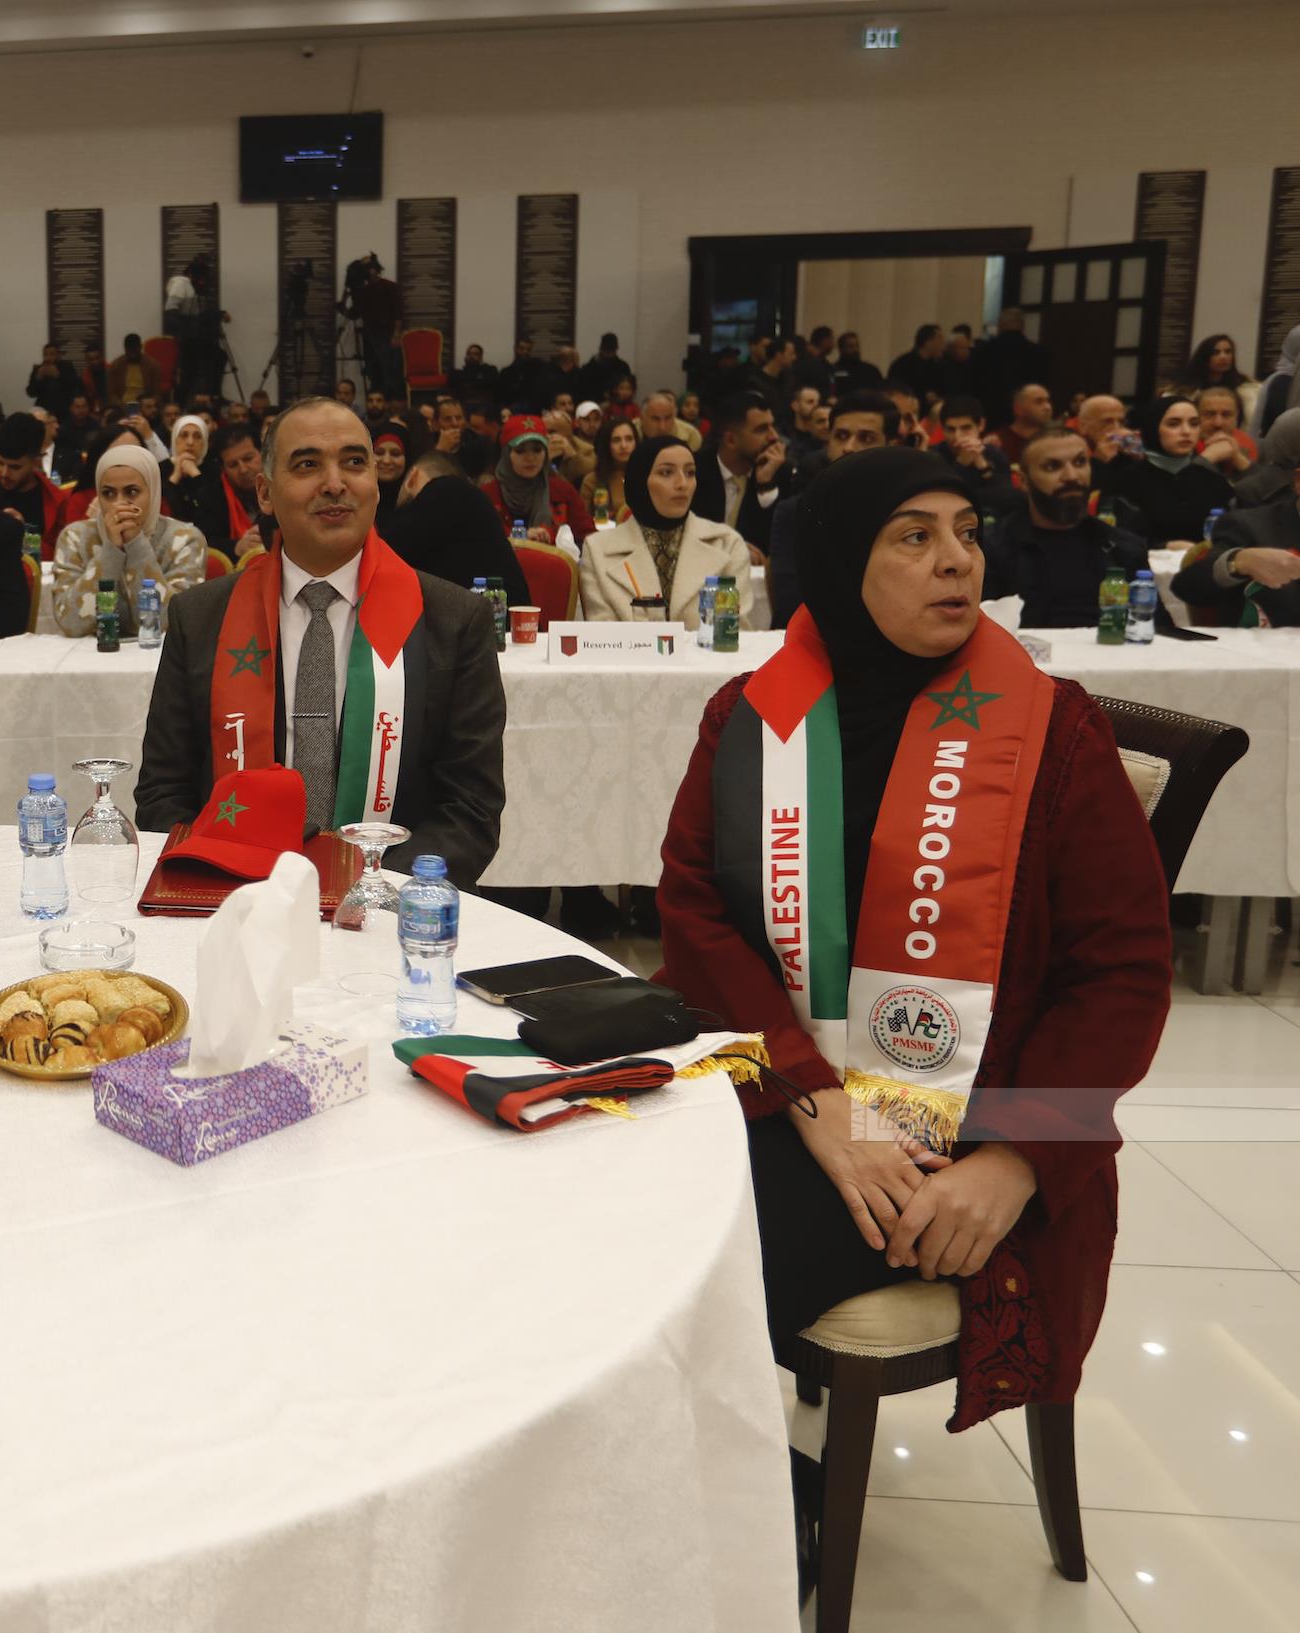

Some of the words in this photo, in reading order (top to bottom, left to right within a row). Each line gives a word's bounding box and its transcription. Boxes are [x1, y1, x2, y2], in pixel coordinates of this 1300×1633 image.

[866, 28, 897, 48] EXIT
[583, 641, 623, 649] Reserved
[224, 712, 245, 771] المغ
[373, 711, 399, 813] فلسطين
[905, 740, 969, 960] MOROCCO
[771, 807, 803, 992] PALESTINE
[892, 1036, 937, 1052] PMSMF
